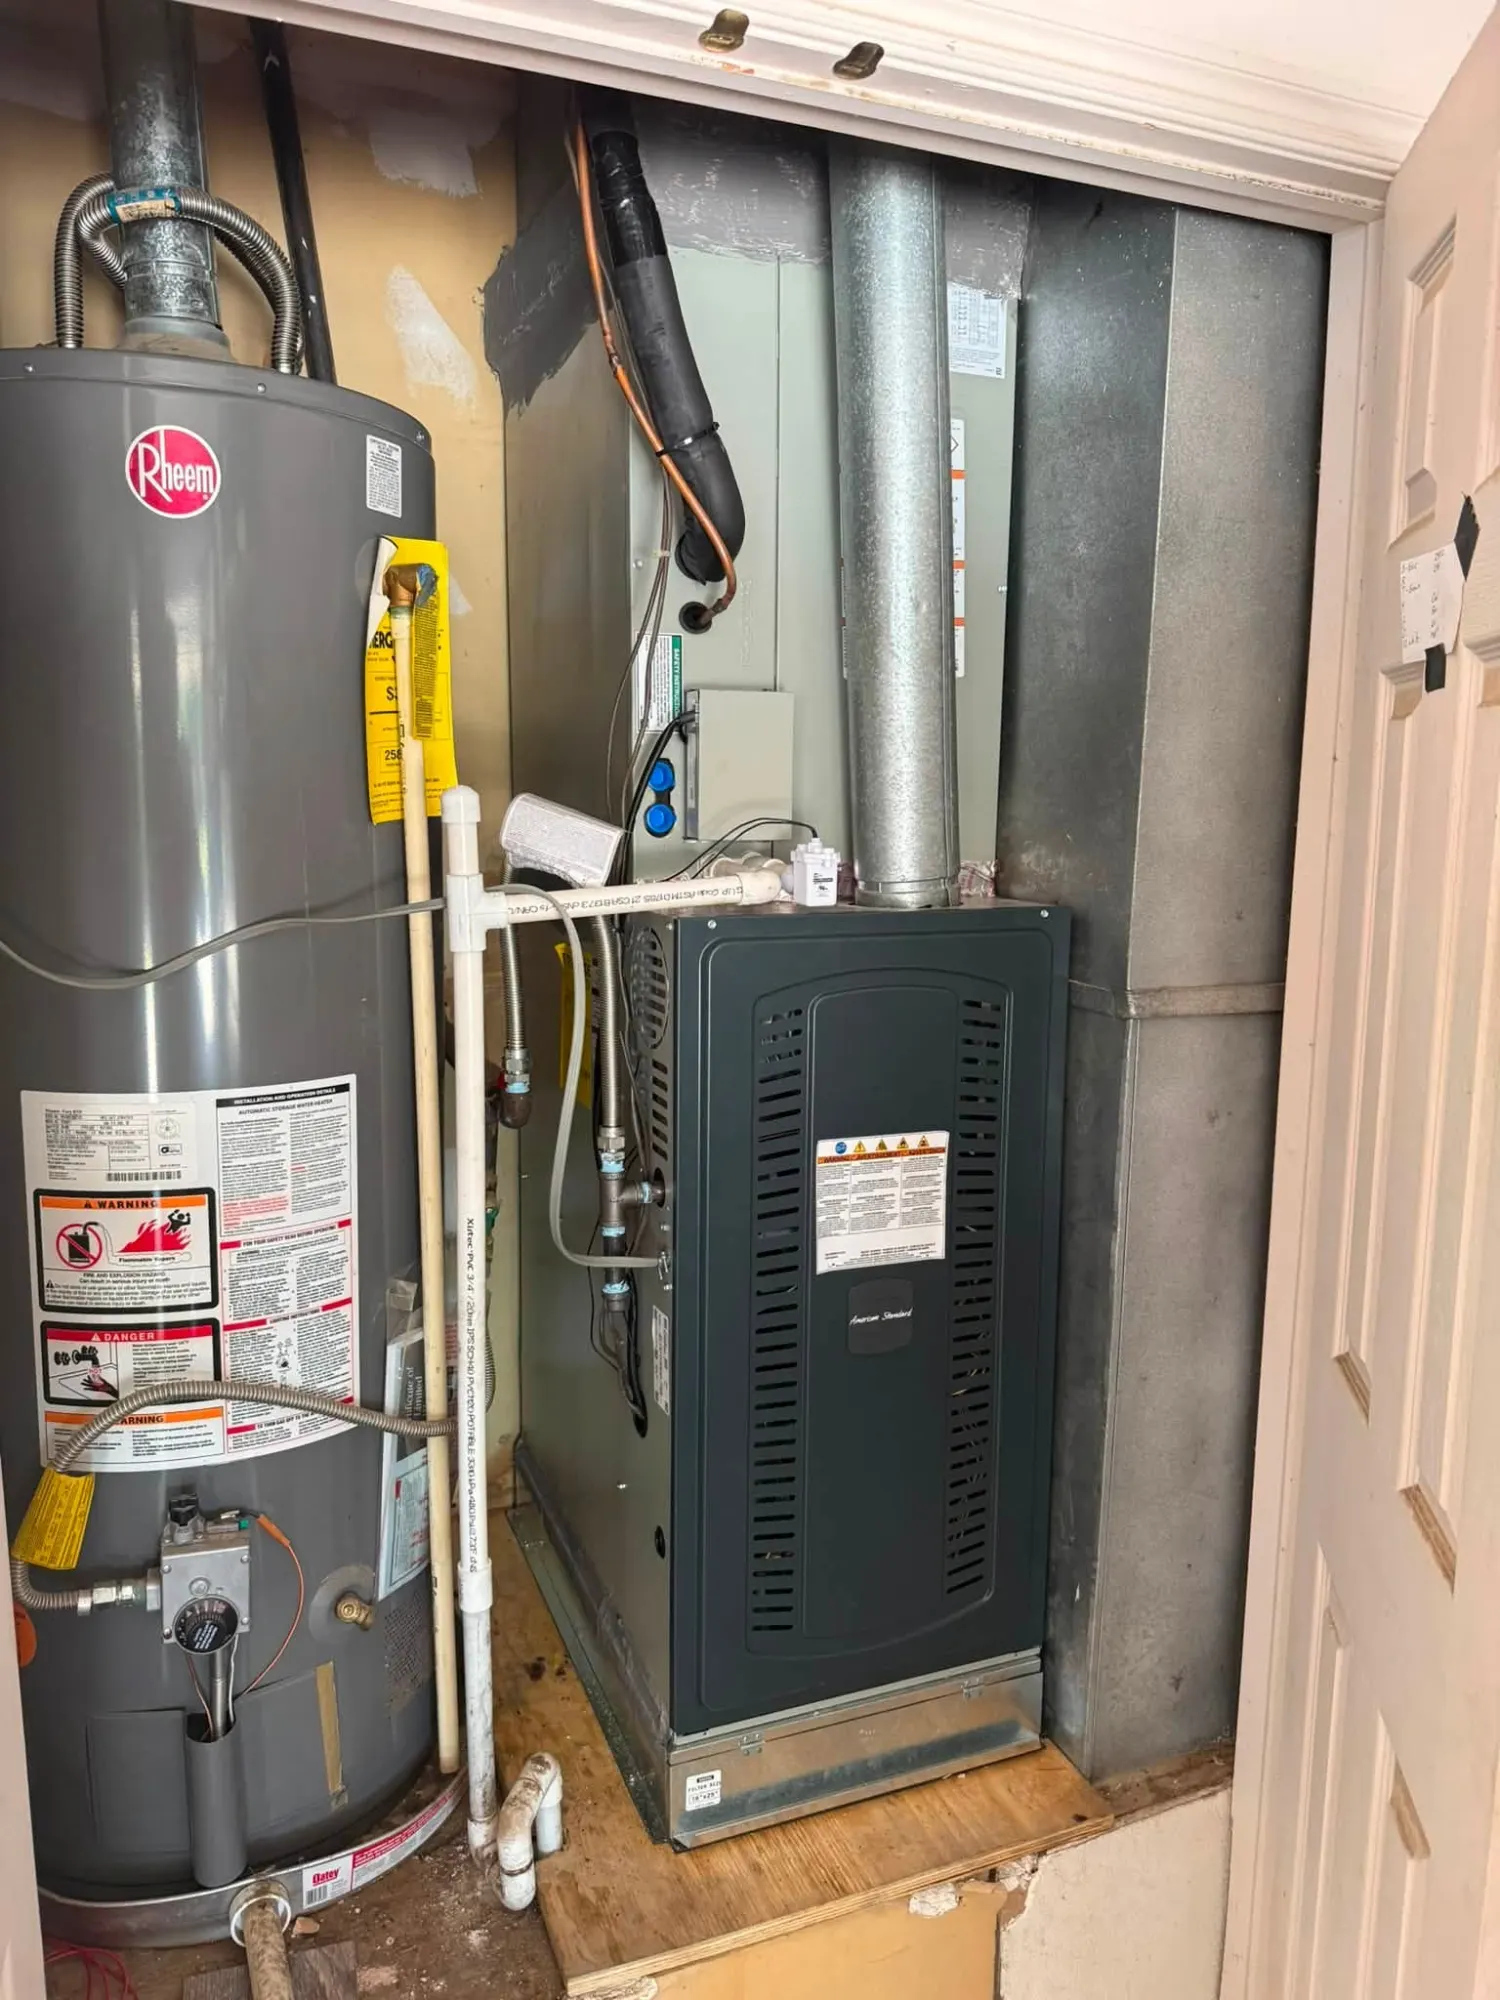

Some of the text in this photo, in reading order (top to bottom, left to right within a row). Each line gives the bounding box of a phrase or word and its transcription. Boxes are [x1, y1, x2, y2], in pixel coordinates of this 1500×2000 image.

[137, 428, 215, 503] Rheem
[238, 1106, 271, 1115] AUTOMATIC
[97, 1200, 158, 1209] WARNING
[103, 1331, 156, 1341] DANGER
[117, 1415, 165, 1426] ARNING
